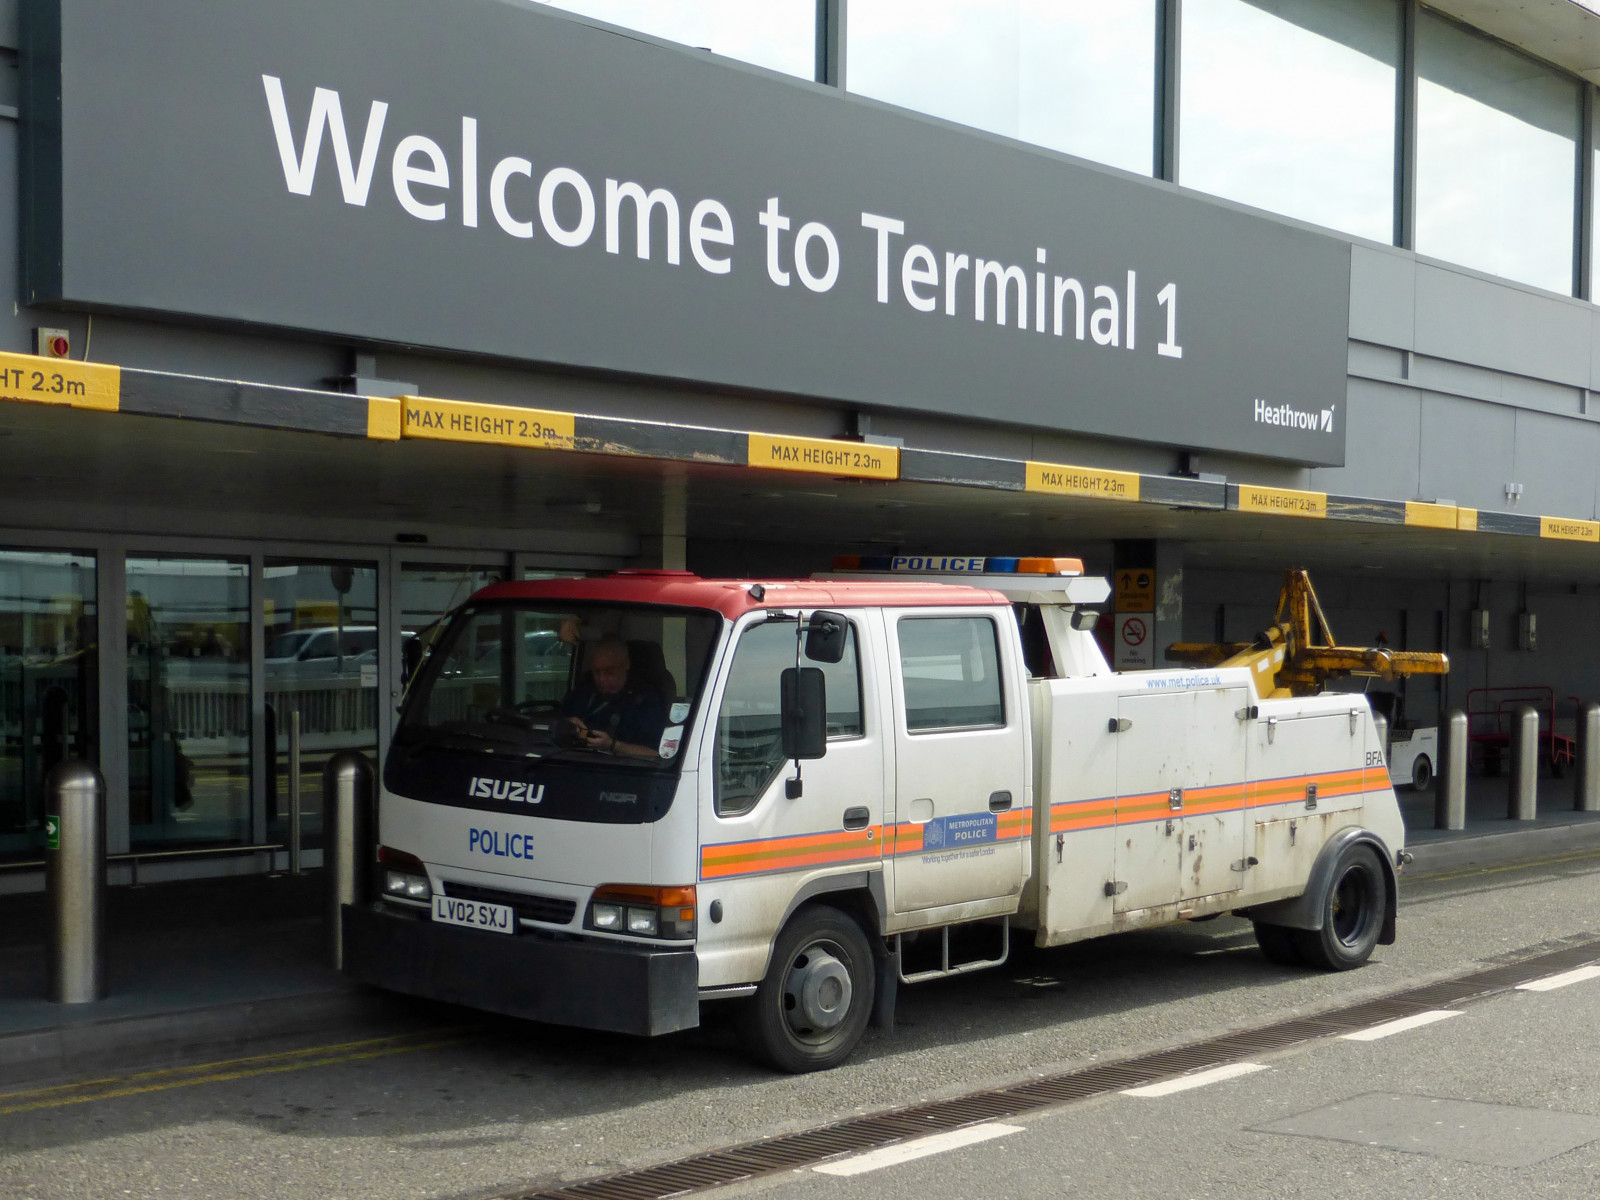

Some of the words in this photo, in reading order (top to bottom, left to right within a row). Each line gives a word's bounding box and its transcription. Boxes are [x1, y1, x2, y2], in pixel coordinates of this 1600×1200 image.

[261, 74, 735, 274] Welcome
[759, 197, 840, 293] to
[861, 212, 1136, 350] Terminal
[1156, 283, 1182, 359] 1
[31, 371, 86, 396] 2.3m
[1254, 398, 1318, 431] Heathrow
[406, 408, 444, 429] MAX
[450, 413, 515, 436] HEIGHT
[518, 421, 557, 440] 2.3m
[771, 444, 799, 462] MAX
[803, 448, 851, 467] HEIGHT
[853, 453, 881, 469] 2.3m
[1041, 472, 1063, 487] MAX
[1065, 475, 1101, 490] HEIGHT
[1251, 493, 1268, 507] MAX
[1270, 495, 1298, 510] HEIGHT
[1548, 523, 1560, 535] MAX
[1560, 524, 1580, 536] HEIGHT
[892, 557, 984, 571] POLICE
[1129, 649, 1138, 657] No
[1146, 674, 1221, 690] www.met.police.uk
[1365, 750, 1383, 766] BFA
[469, 777, 545, 803] ISUZU
[949, 817, 994, 830] METROPOLITAN
[470, 828, 534, 860] POLICE
[955, 829, 988, 841] POLICE
[438, 899, 475, 923] LV02
[479, 905, 507, 929] SXJ
